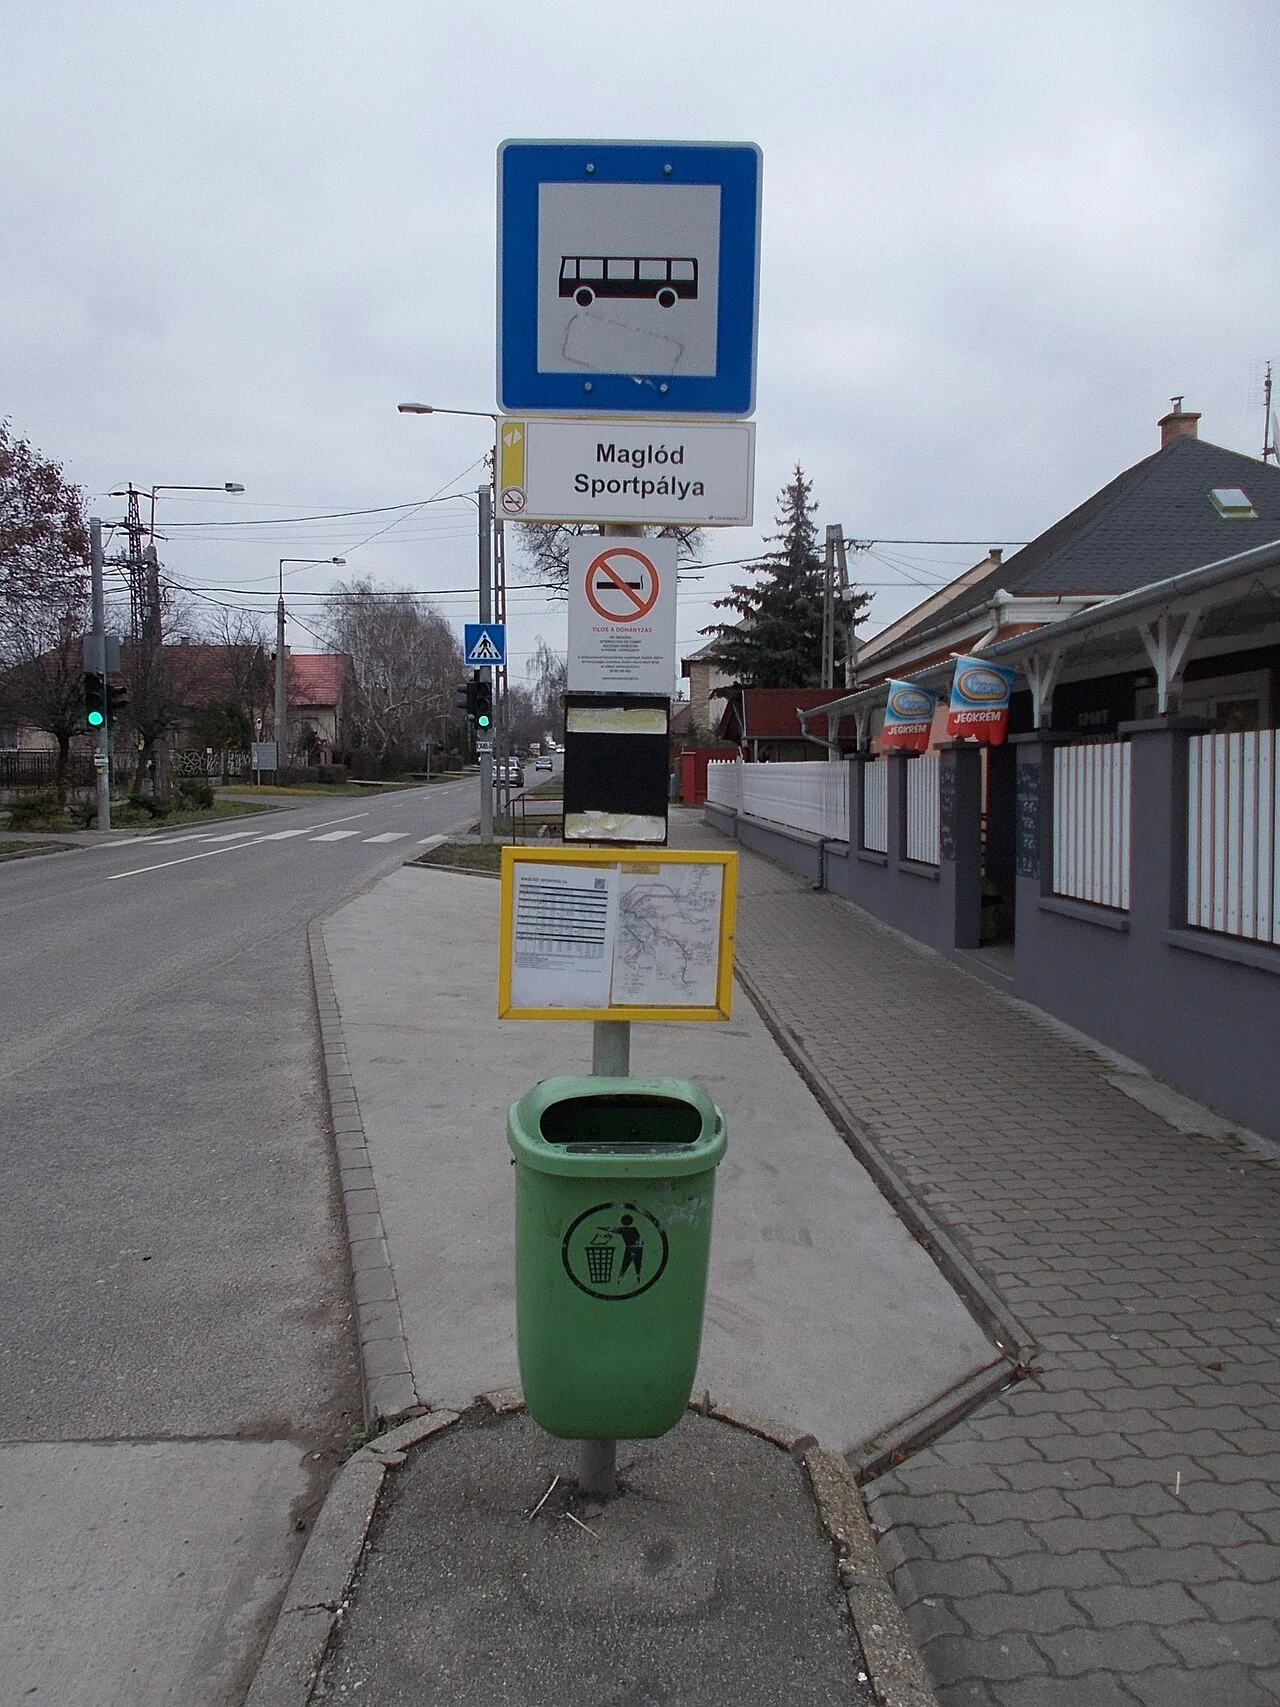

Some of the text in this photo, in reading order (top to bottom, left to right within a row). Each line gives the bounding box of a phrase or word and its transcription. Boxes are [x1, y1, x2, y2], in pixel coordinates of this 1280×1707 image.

[596, 443, 685, 469] Maglód
[574, 473, 705, 500] Sportpálya
[953, 709, 1002, 724] JÉGKRÉM
[887, 723, 927, 735] JÉGKRÉM
